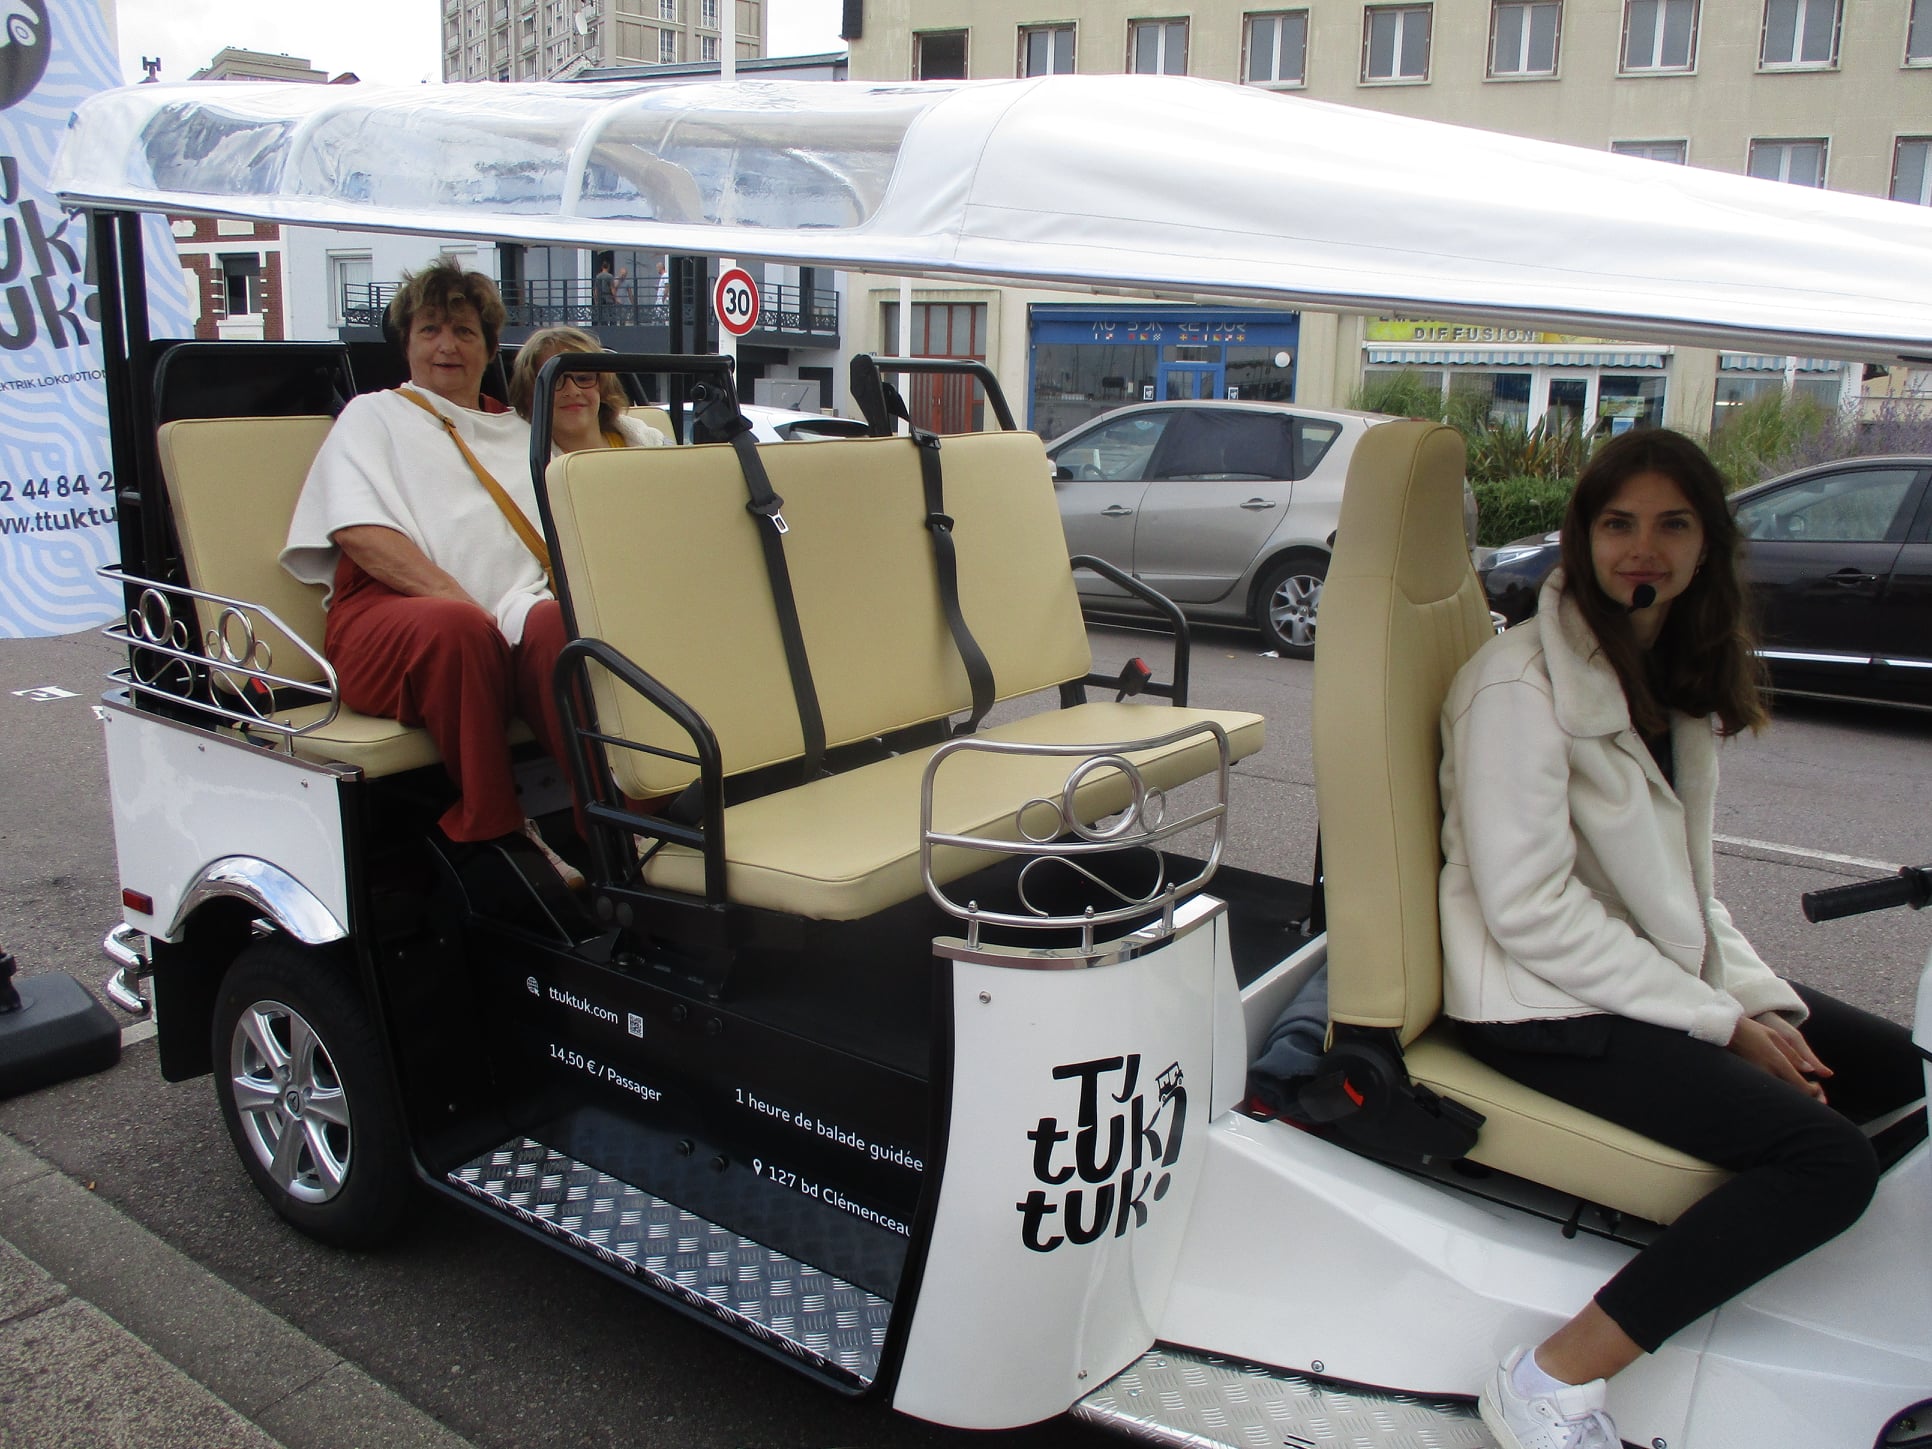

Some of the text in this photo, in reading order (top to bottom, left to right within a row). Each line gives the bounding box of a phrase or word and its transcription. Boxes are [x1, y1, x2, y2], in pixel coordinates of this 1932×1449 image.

[725, 287, 750, 316] 30
[1414, 326, 1536, 342] DIFFUSION
[22, 479, 50, 500] 44
[56, 474, 90, 497] 84
[549, 986, 619, 1025] ttuktuk.com
[550, 1043, 584, 1069] 14,50
[586, 1059, 596, 1075] €
[607, 1067, 662, 1102] Passager
[735, 1088, 924, 1173] 1 heure de balade guidée
[769, 1166, 797, 1188] 127
[801, 1178, 818, 1198] bd
